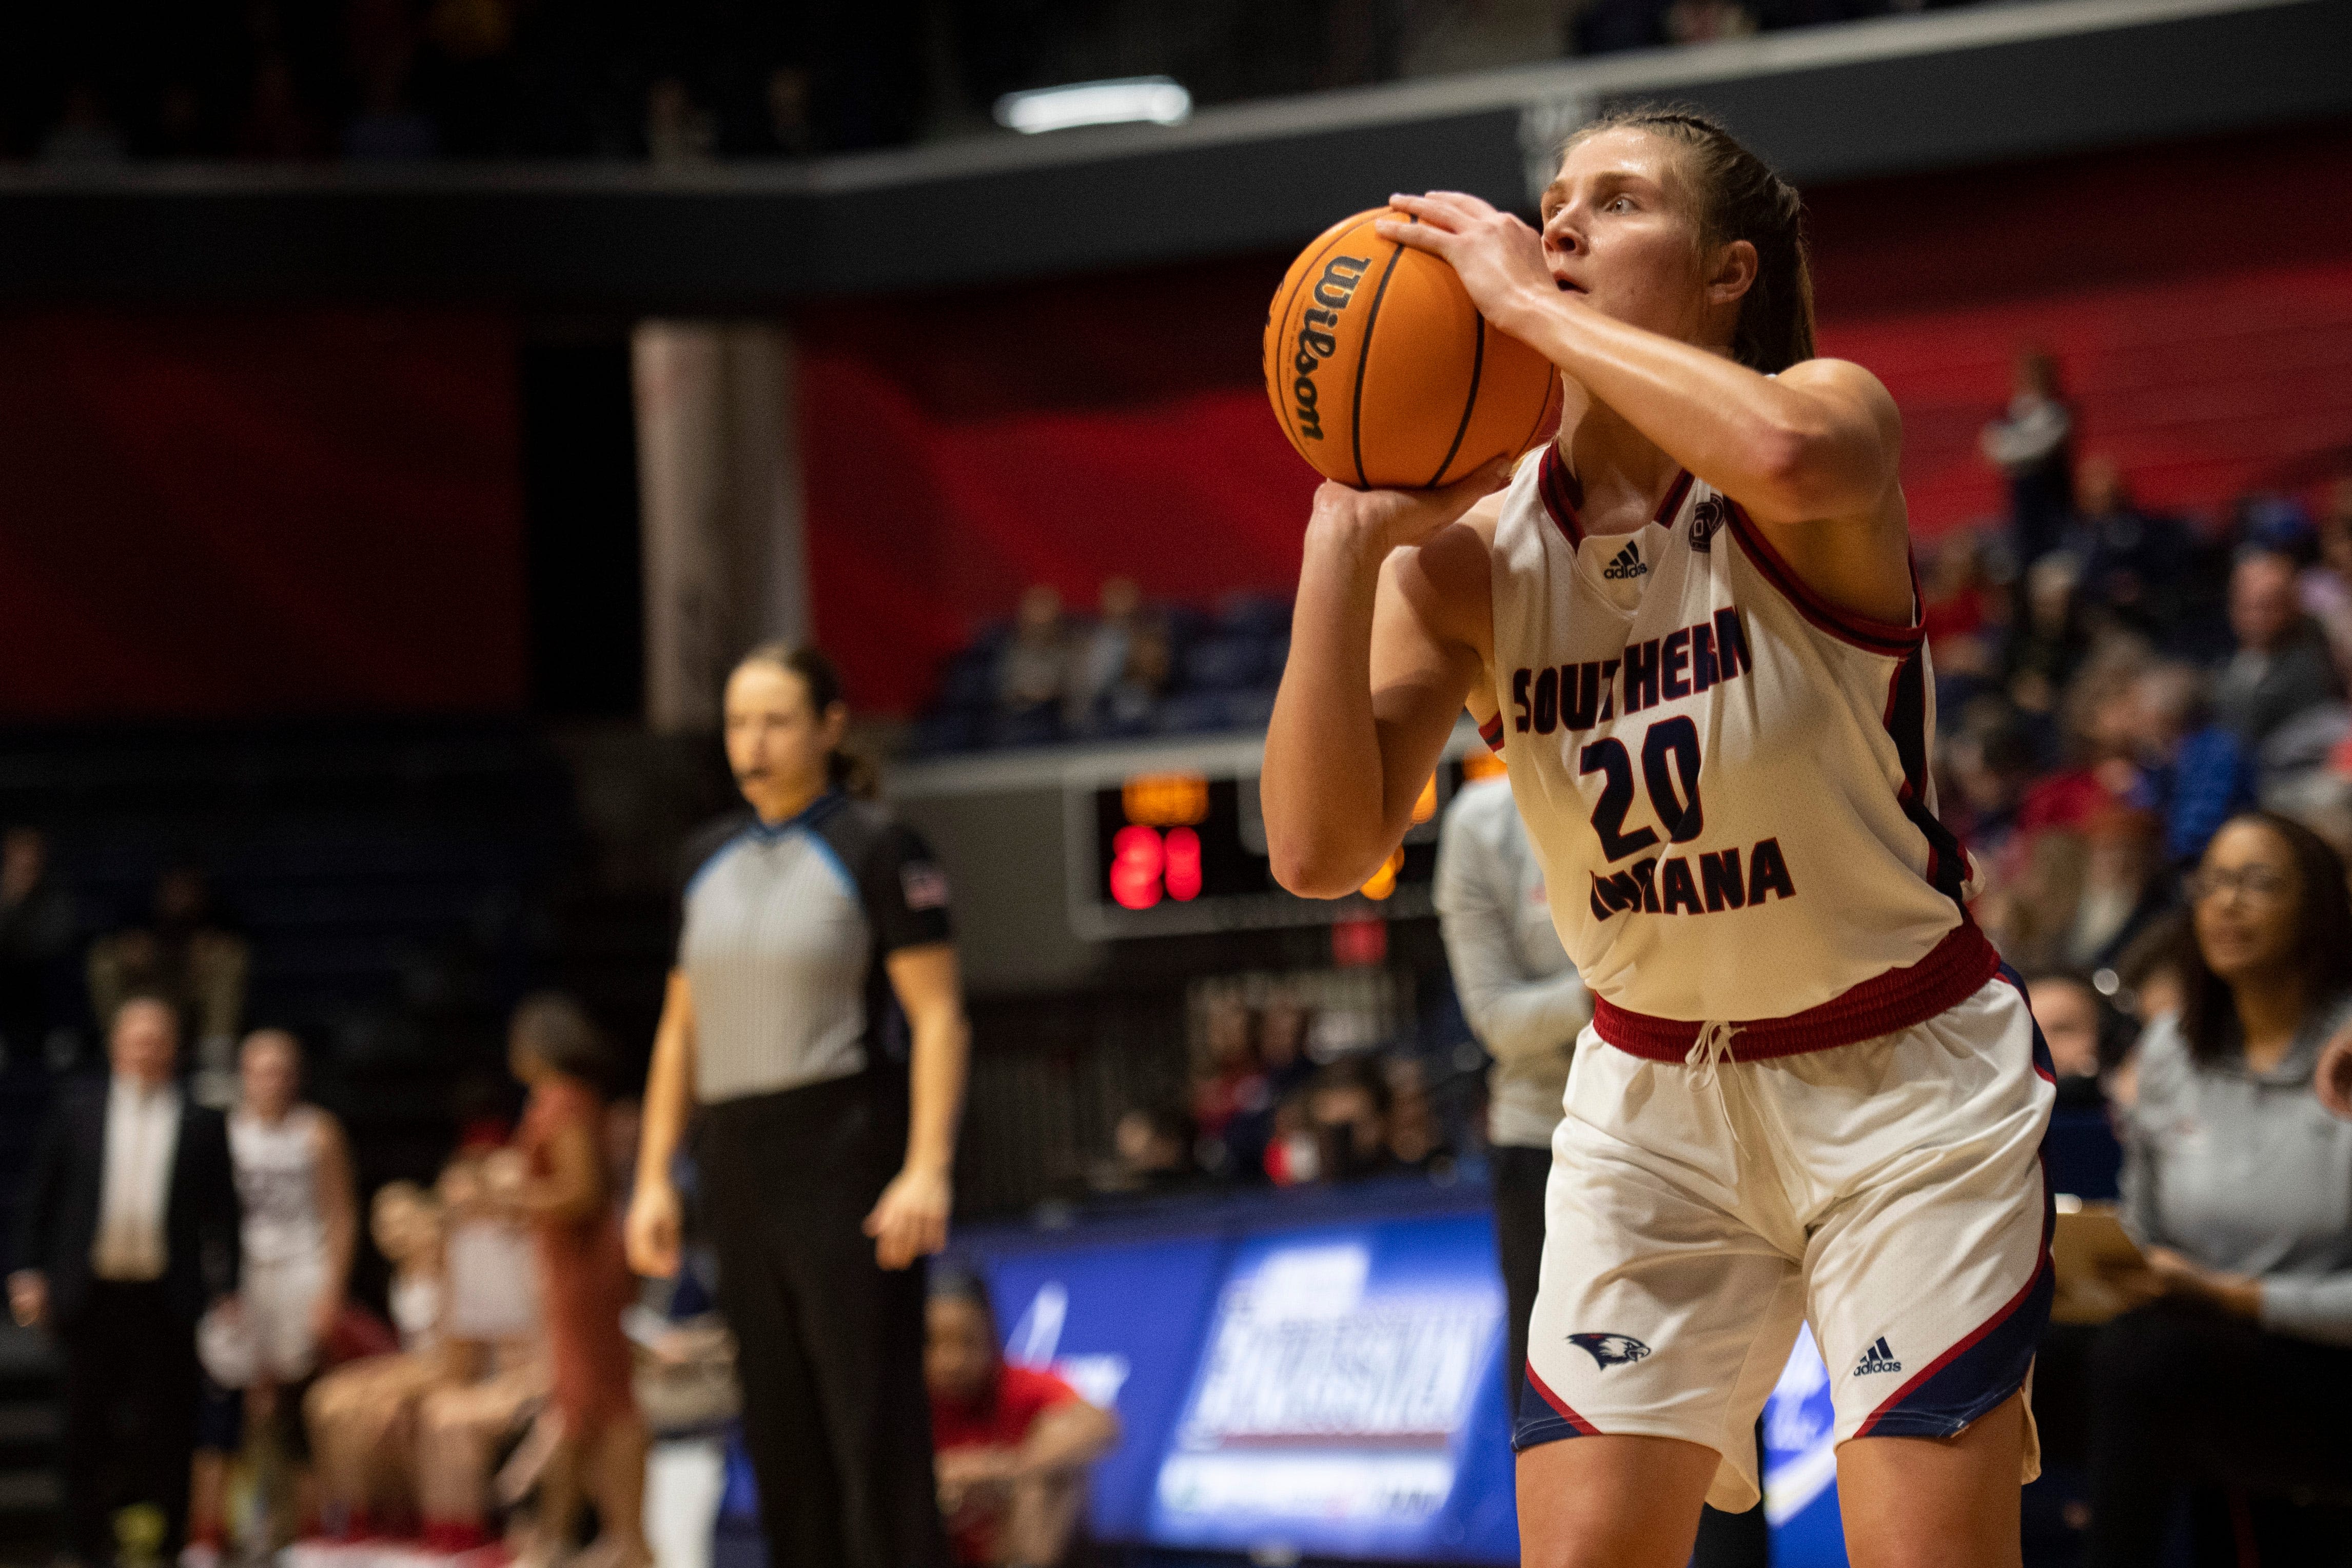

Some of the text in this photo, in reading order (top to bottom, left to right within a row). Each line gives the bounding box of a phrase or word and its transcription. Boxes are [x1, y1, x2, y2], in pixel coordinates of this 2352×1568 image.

[1295, 256, 1371, 439] Wilson
[1514, 605, 1752, 734] SOUTHERN
[1579, 715, 1703, 862] 20
[1853, 1361, 1902, 1377] adidas
